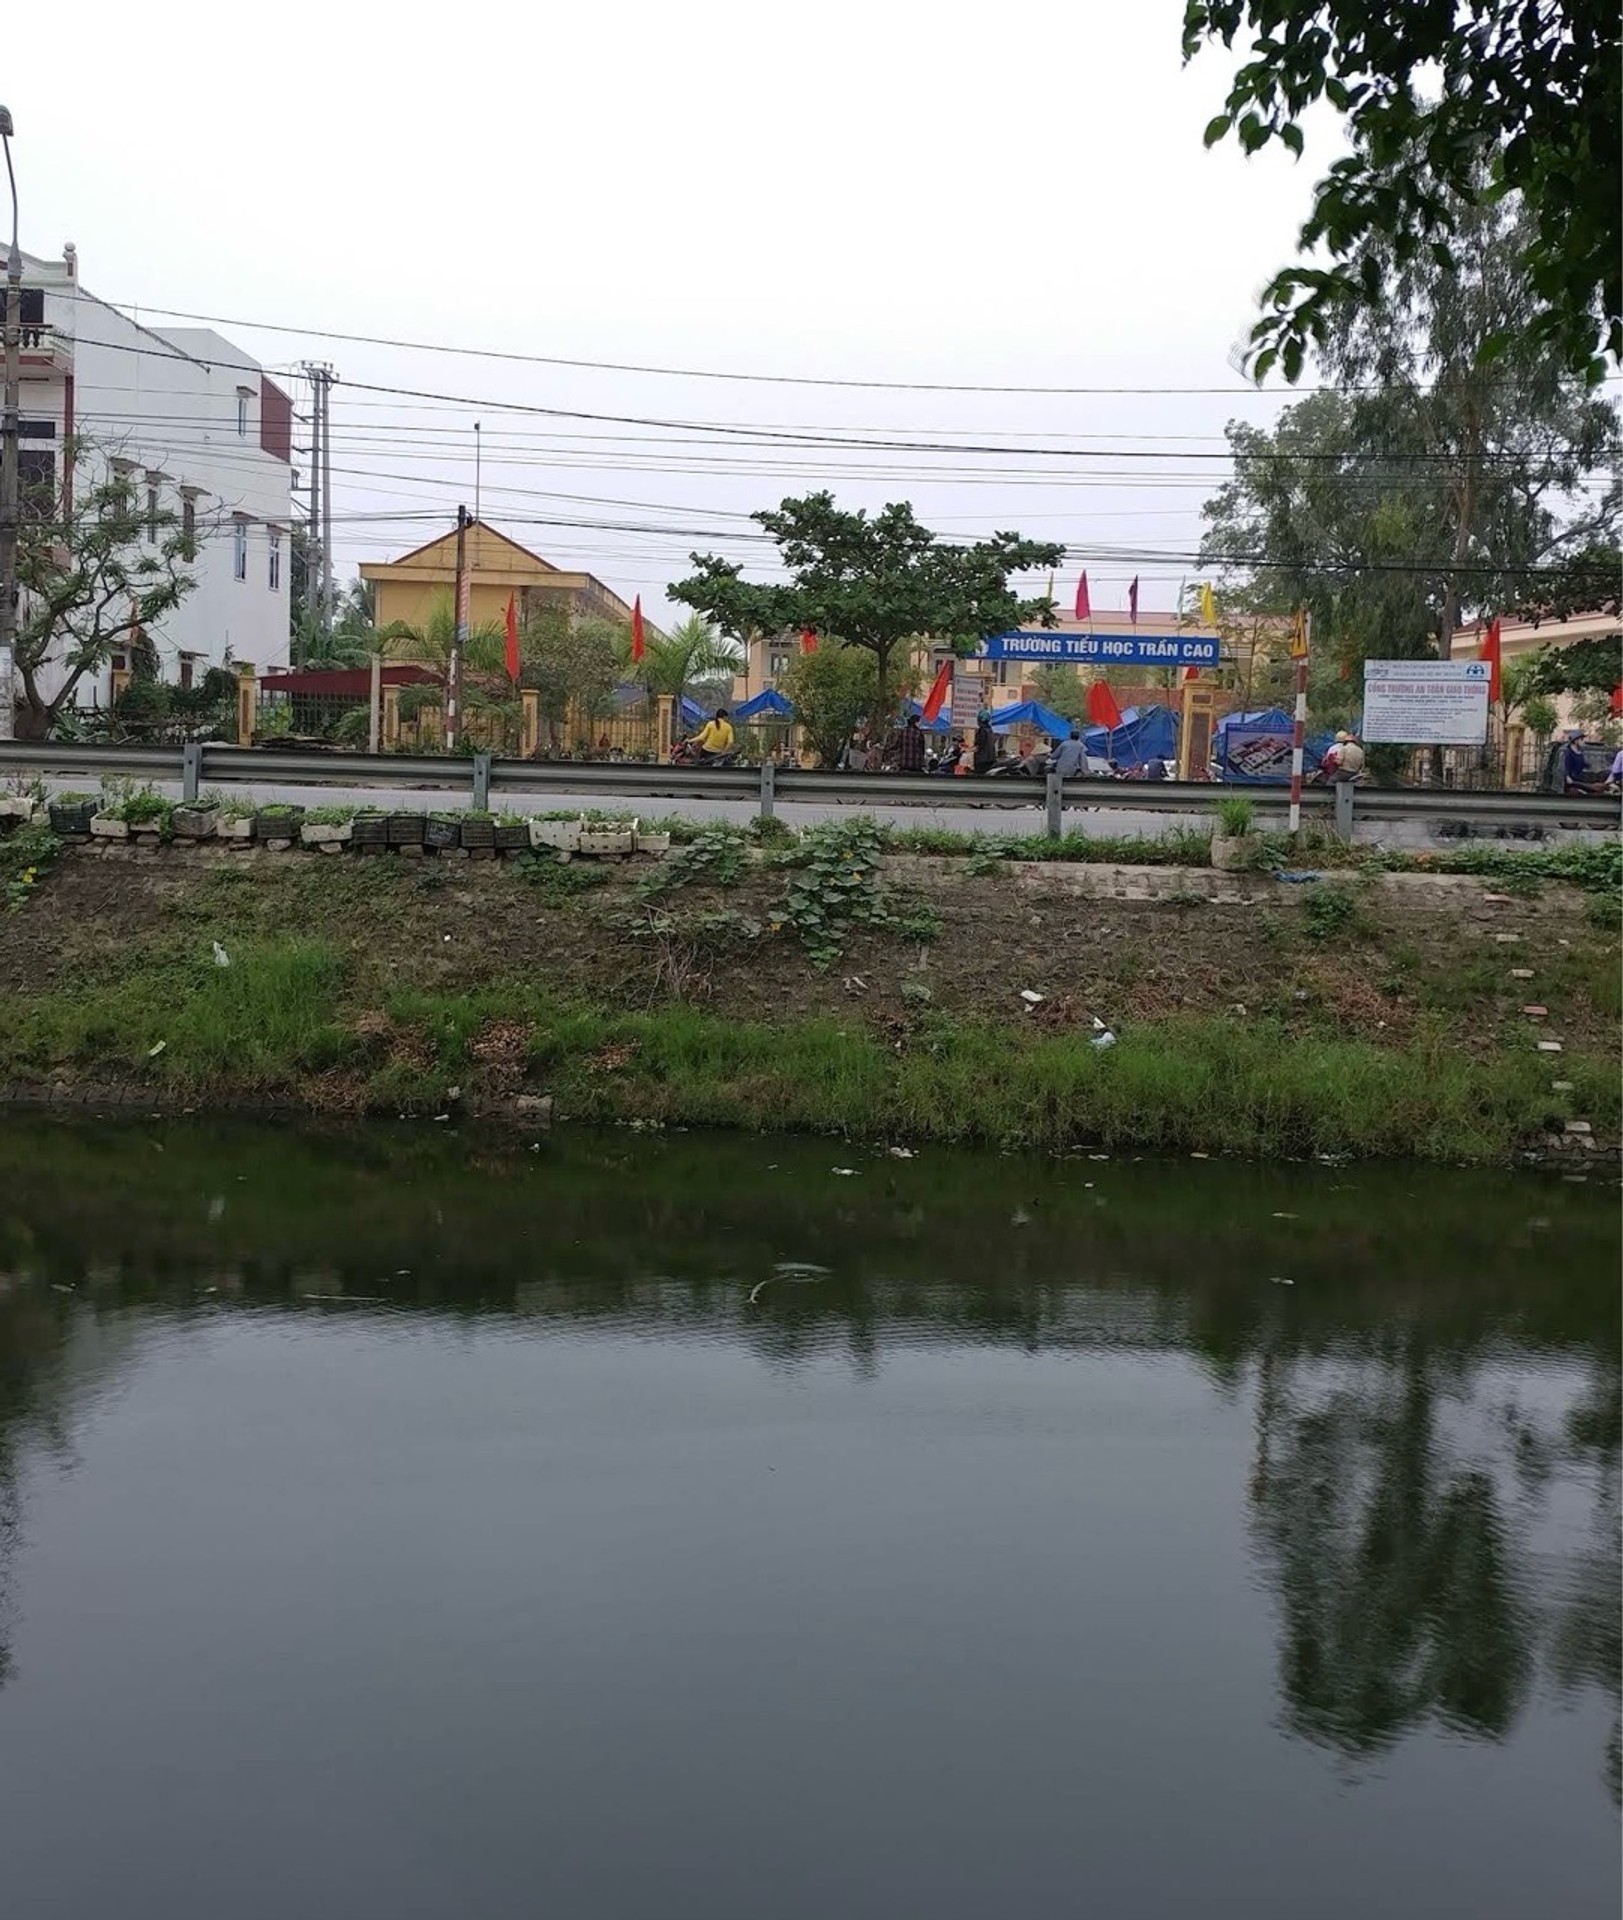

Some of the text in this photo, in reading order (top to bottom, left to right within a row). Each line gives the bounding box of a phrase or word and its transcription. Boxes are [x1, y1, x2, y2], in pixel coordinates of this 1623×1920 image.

[1002, 636, 1061, 652] TRƯỜNG
[1103, 641, 1134, 656] HỌC
[1183, 643, 1213, 657] CAO
